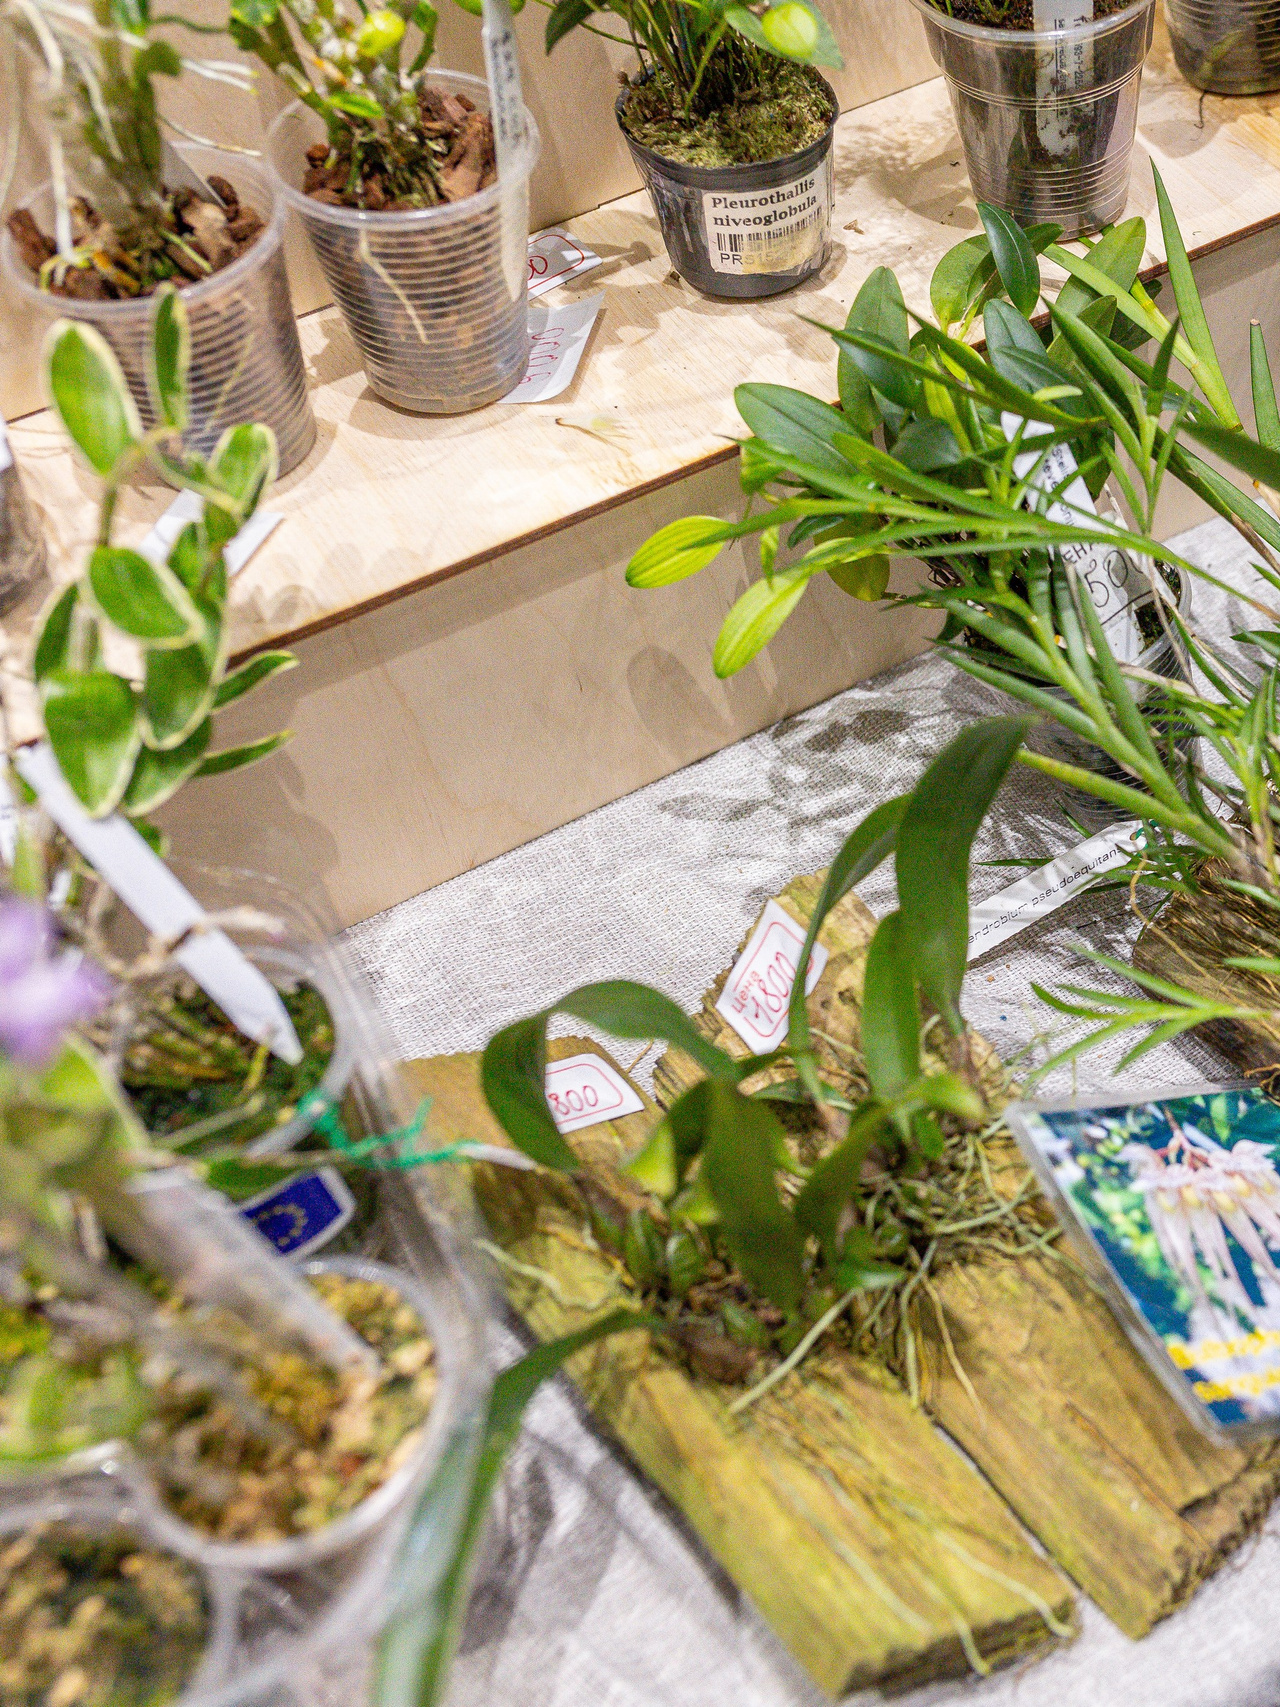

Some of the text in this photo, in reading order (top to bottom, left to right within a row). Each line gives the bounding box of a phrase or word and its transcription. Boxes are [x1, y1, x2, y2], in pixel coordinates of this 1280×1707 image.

[711, 178, 815, 209] Pleurothallis
[713, 195, 817, 227] niveoglobula
[968, 902, 1027, 944] endrobium
[732, 970, 760, 1014] Цена
